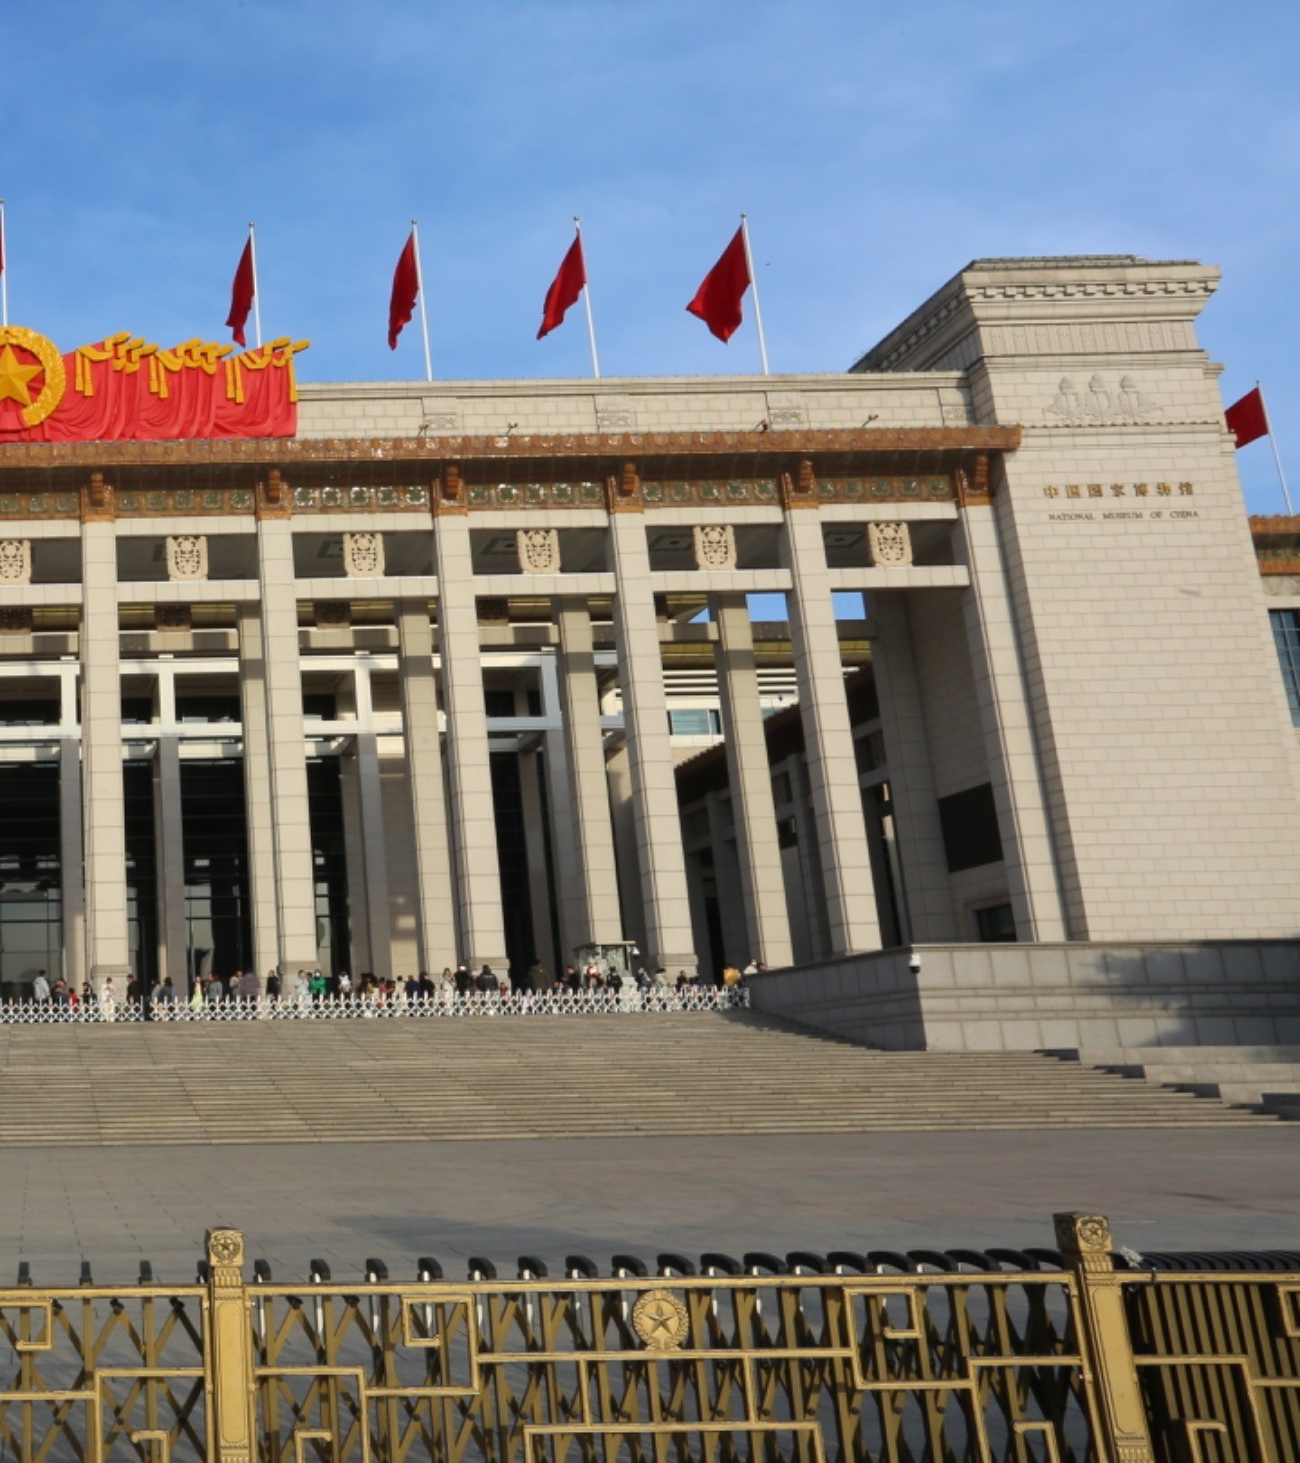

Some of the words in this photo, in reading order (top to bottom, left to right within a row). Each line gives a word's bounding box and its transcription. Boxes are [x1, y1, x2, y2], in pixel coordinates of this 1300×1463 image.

[1043, 482, 1194, 499] 中国国家博物馆
[1049, 512, 1095, 521] NATIONAL
[1102, 511, 1143, 520] MUSEUM
[1150, 511, 1163, 519] OF
[1169, 510, 1199, 518] CHINA
